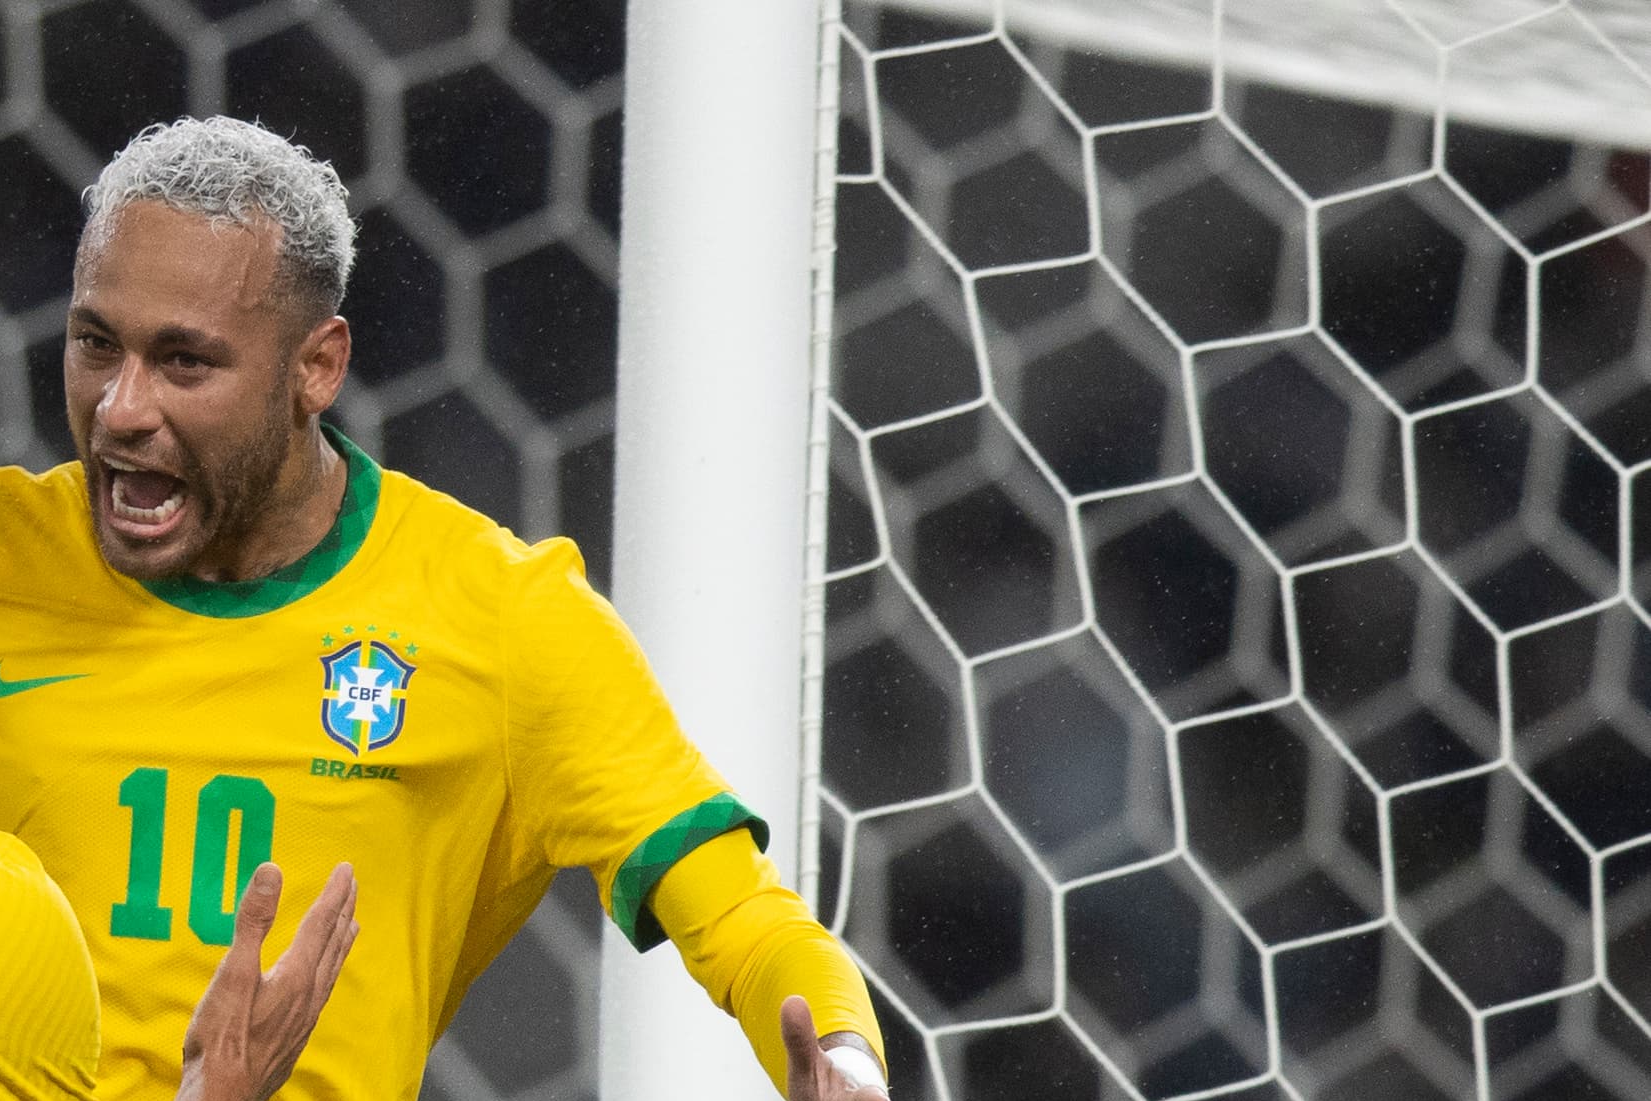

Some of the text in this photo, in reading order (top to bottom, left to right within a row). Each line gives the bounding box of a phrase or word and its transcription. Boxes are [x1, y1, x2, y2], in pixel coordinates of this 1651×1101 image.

[348, 685, 382, 702] CBF
[310, 757, 401, 780] BRASIL
[110, 766, 277, 947] 10
